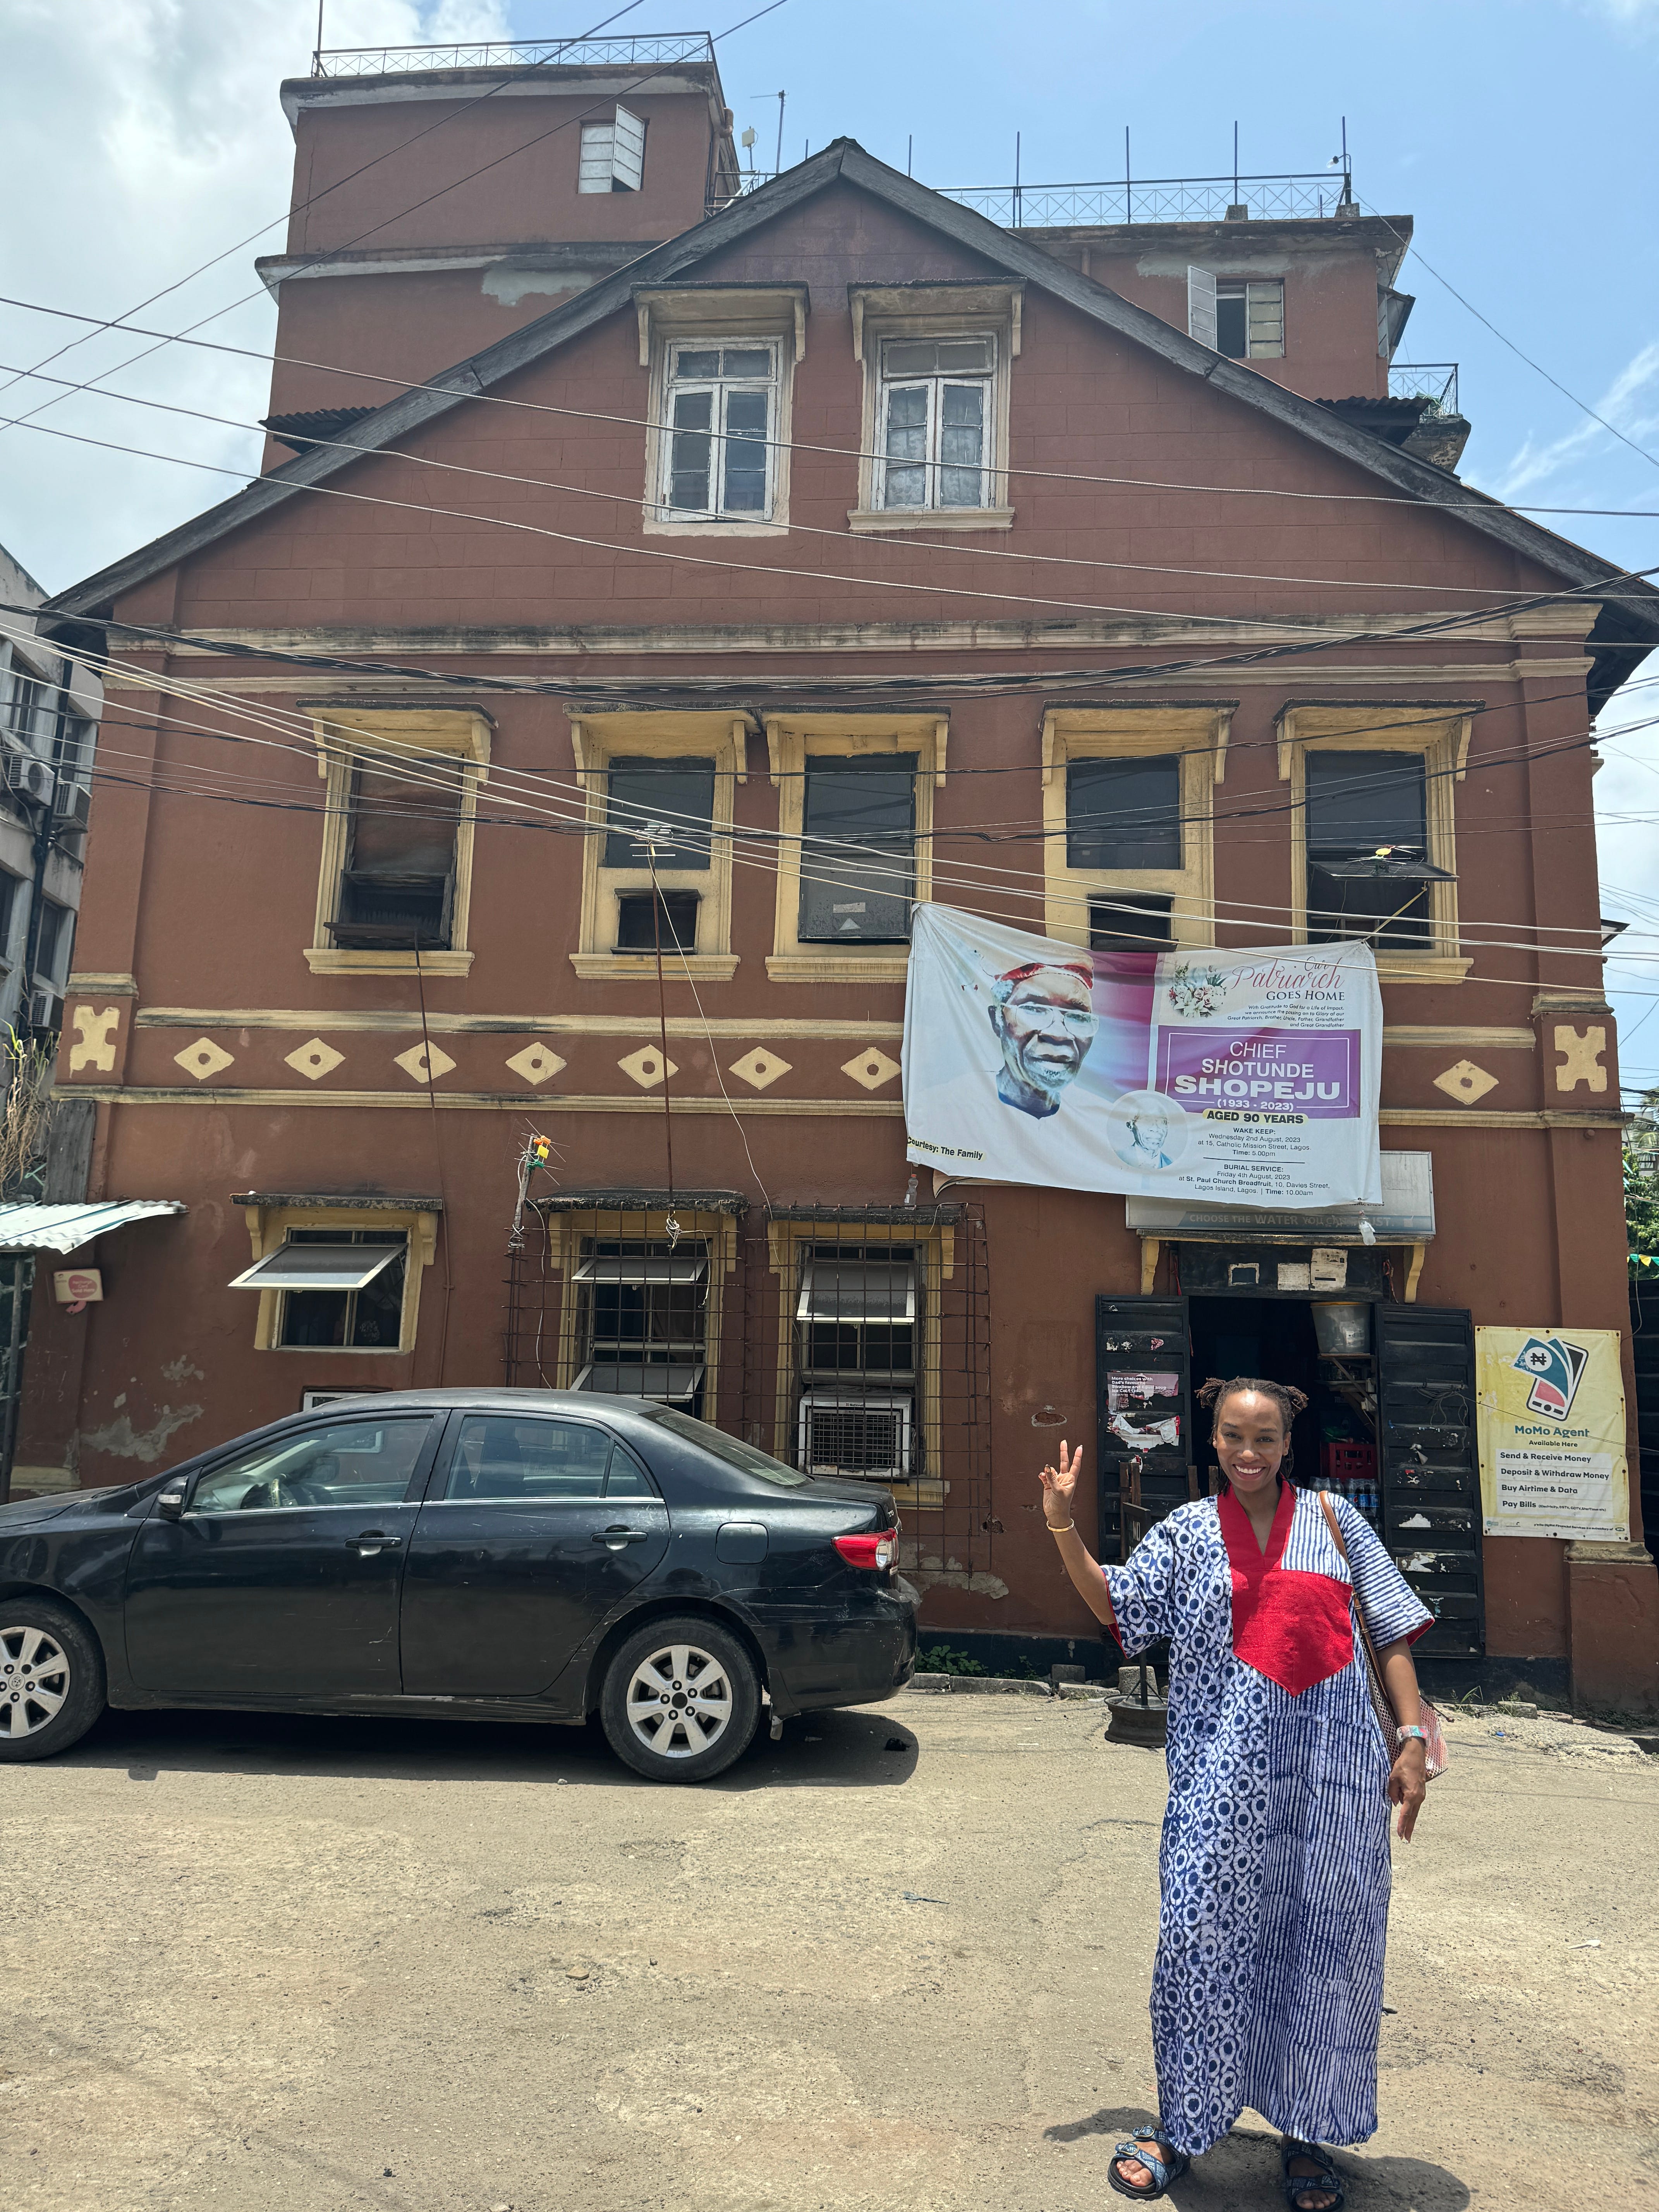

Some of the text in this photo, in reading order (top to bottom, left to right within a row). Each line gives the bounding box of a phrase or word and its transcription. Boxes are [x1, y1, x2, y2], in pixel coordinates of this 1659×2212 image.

[1305, 956, 1329, 971] Our
[1231, 957, 1345, 989] Patriarch
[1266, 991, 1345, 1001] GOES HOME
[1230, 1041, 1286, 1059] CHIEF
[1201, 1058, 1314, 1078] SHOTUNDE
[1174, 1075, 1340, 1100] SHOPEJU
[1217, 1098, 1250, 1109] (1933
[1260, 1101, 1294, 1112] 2023)
[1207, 1110, 1304, 1124] AGED 90 YEARS
[1209, 1133, 1244, 1142] Wednesday
[908, 1137, 983, 1160] Courtesy: The Family
[1254, 1215, 1298, 1225] WATER
[1302, 1217, 1323, 1225] YOU
[1515, 1425, 1590, 1438] MoMo Agent
[1565, 1455, 1591, 1463] Money
[1542, 1470, 1581, 1478] Withdraw
[1583, 1472, 1609, 1480] Money
[1133, 1520, 1140, 1541] NO
